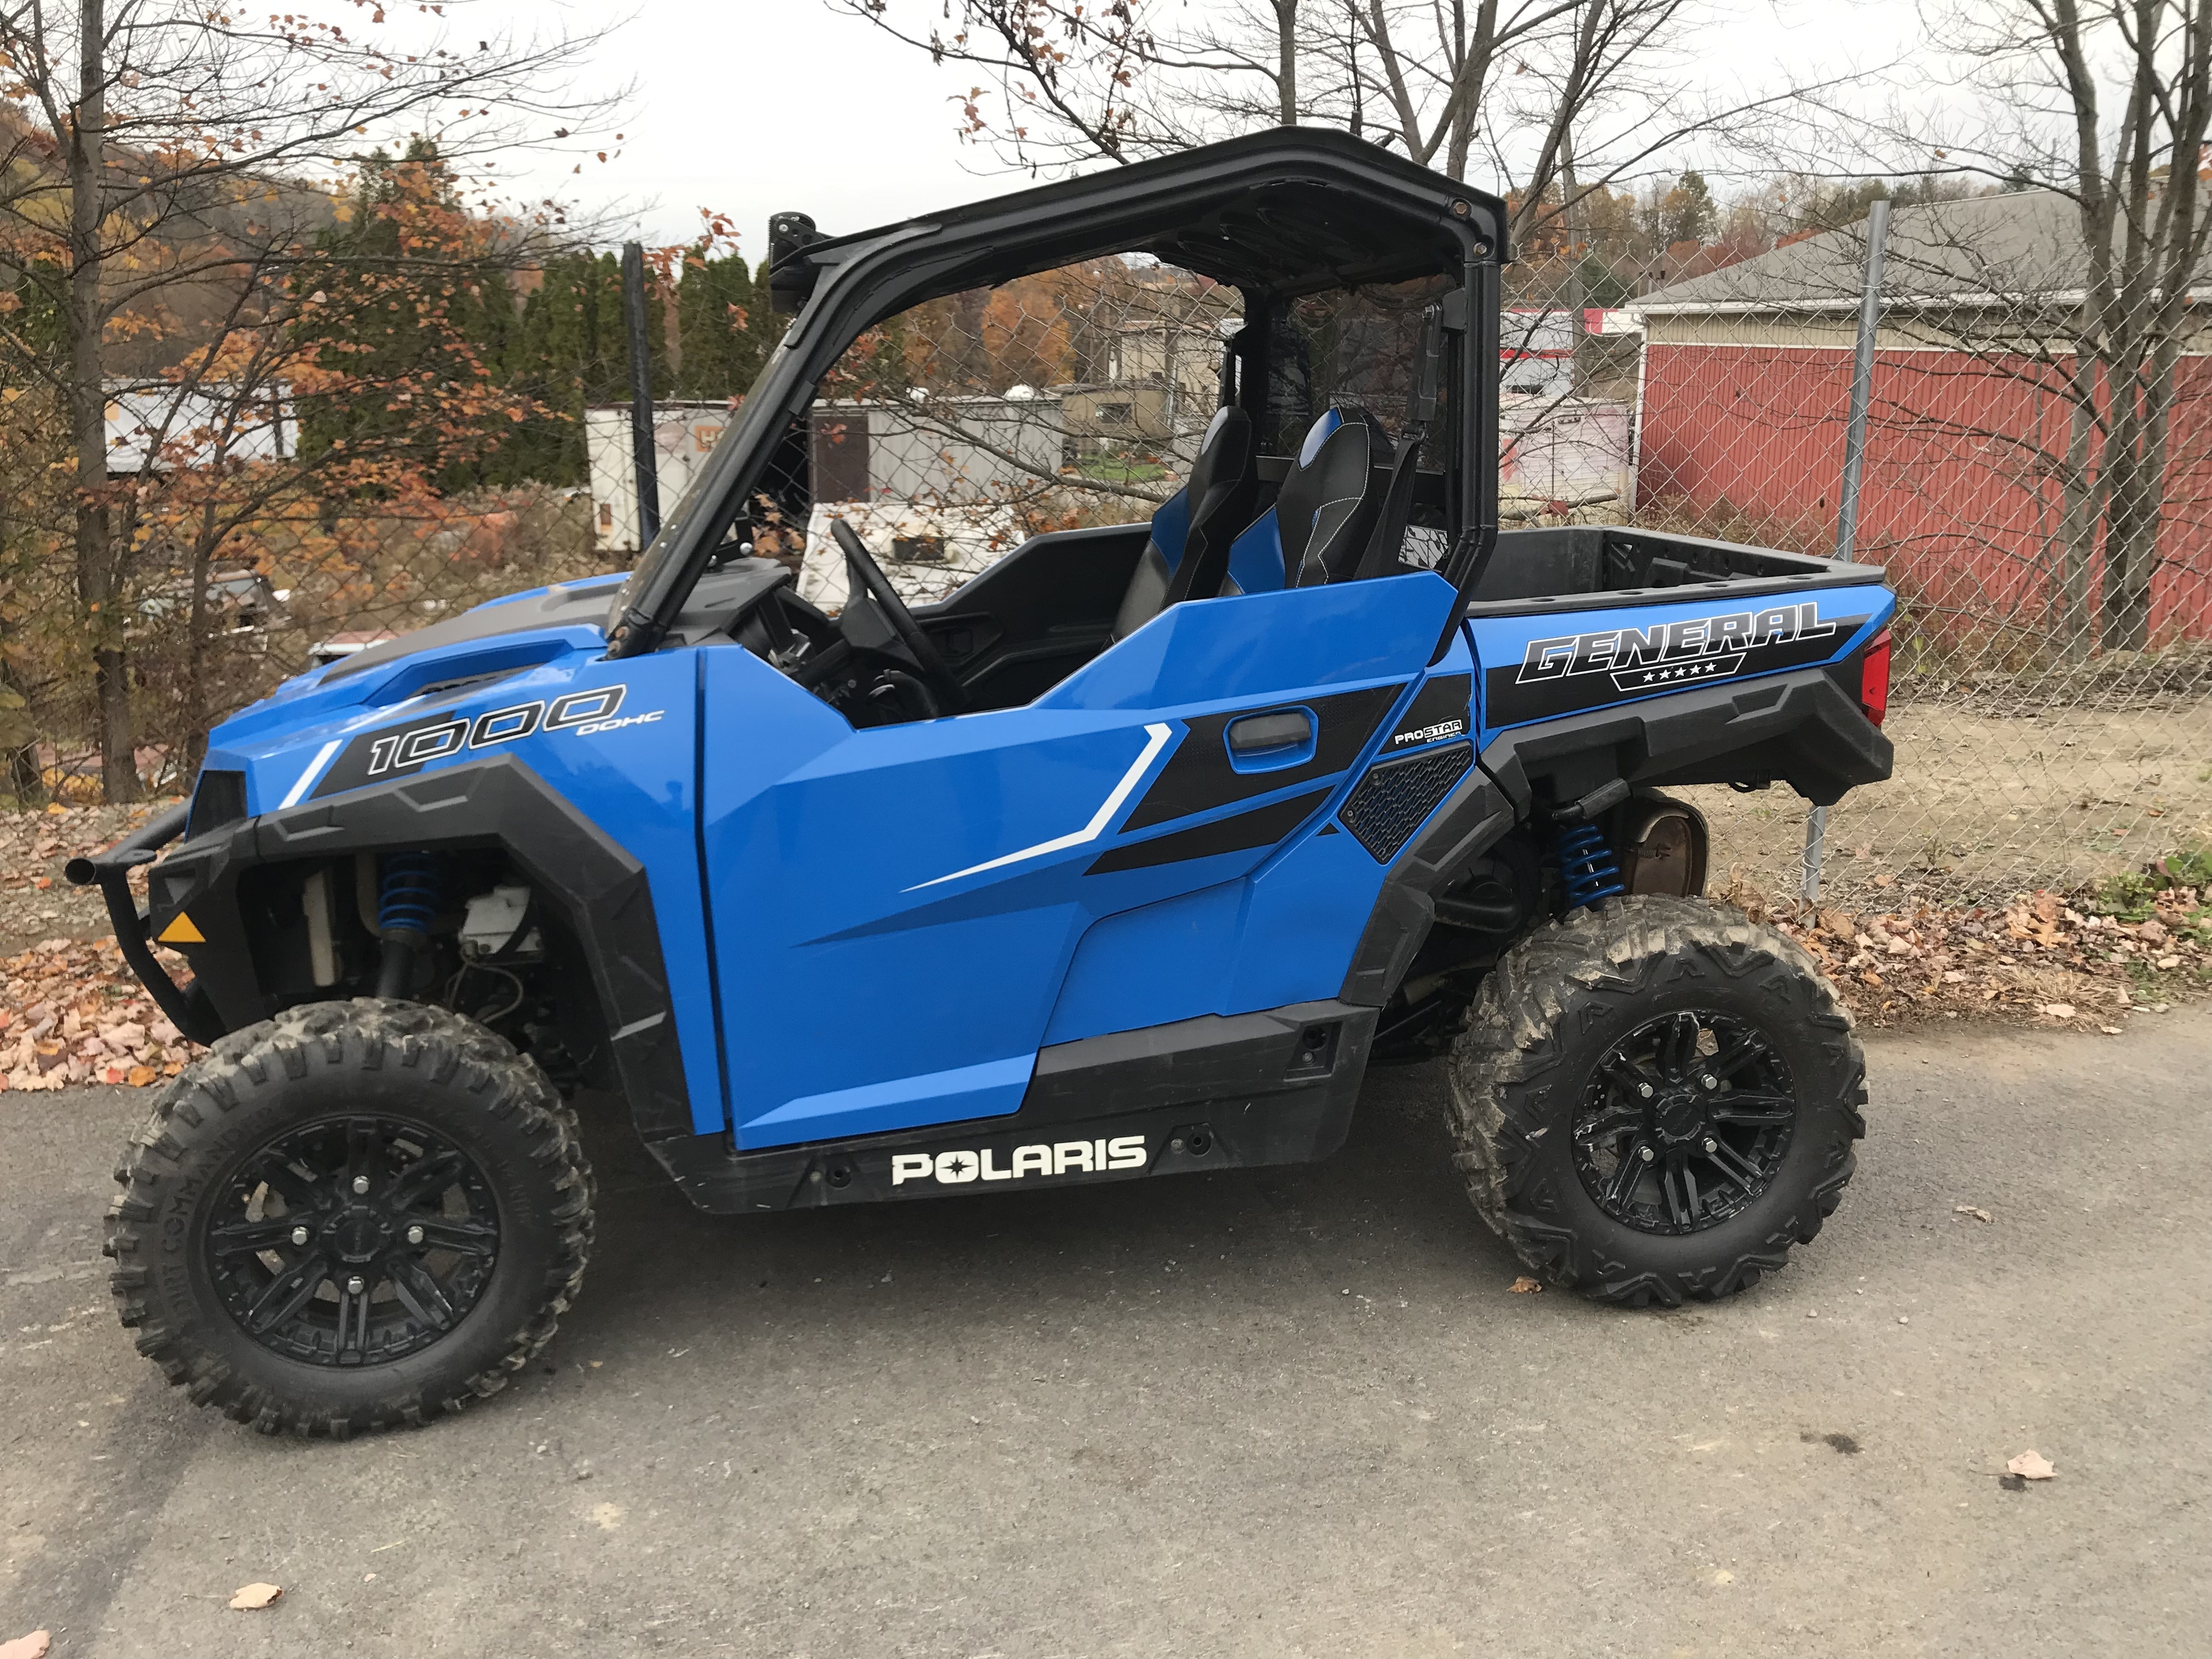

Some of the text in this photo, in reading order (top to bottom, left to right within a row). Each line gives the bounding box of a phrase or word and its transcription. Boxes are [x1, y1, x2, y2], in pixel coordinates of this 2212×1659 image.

[1515, 601, 1836, 684] GENERAL
[367, 684, 627, 775] 1000
[575, 710, 665, 736] DOHC
[1395, 720, 1463, 744] PROSTAR
[891, 1135, 1148, 1186] POLARIS
